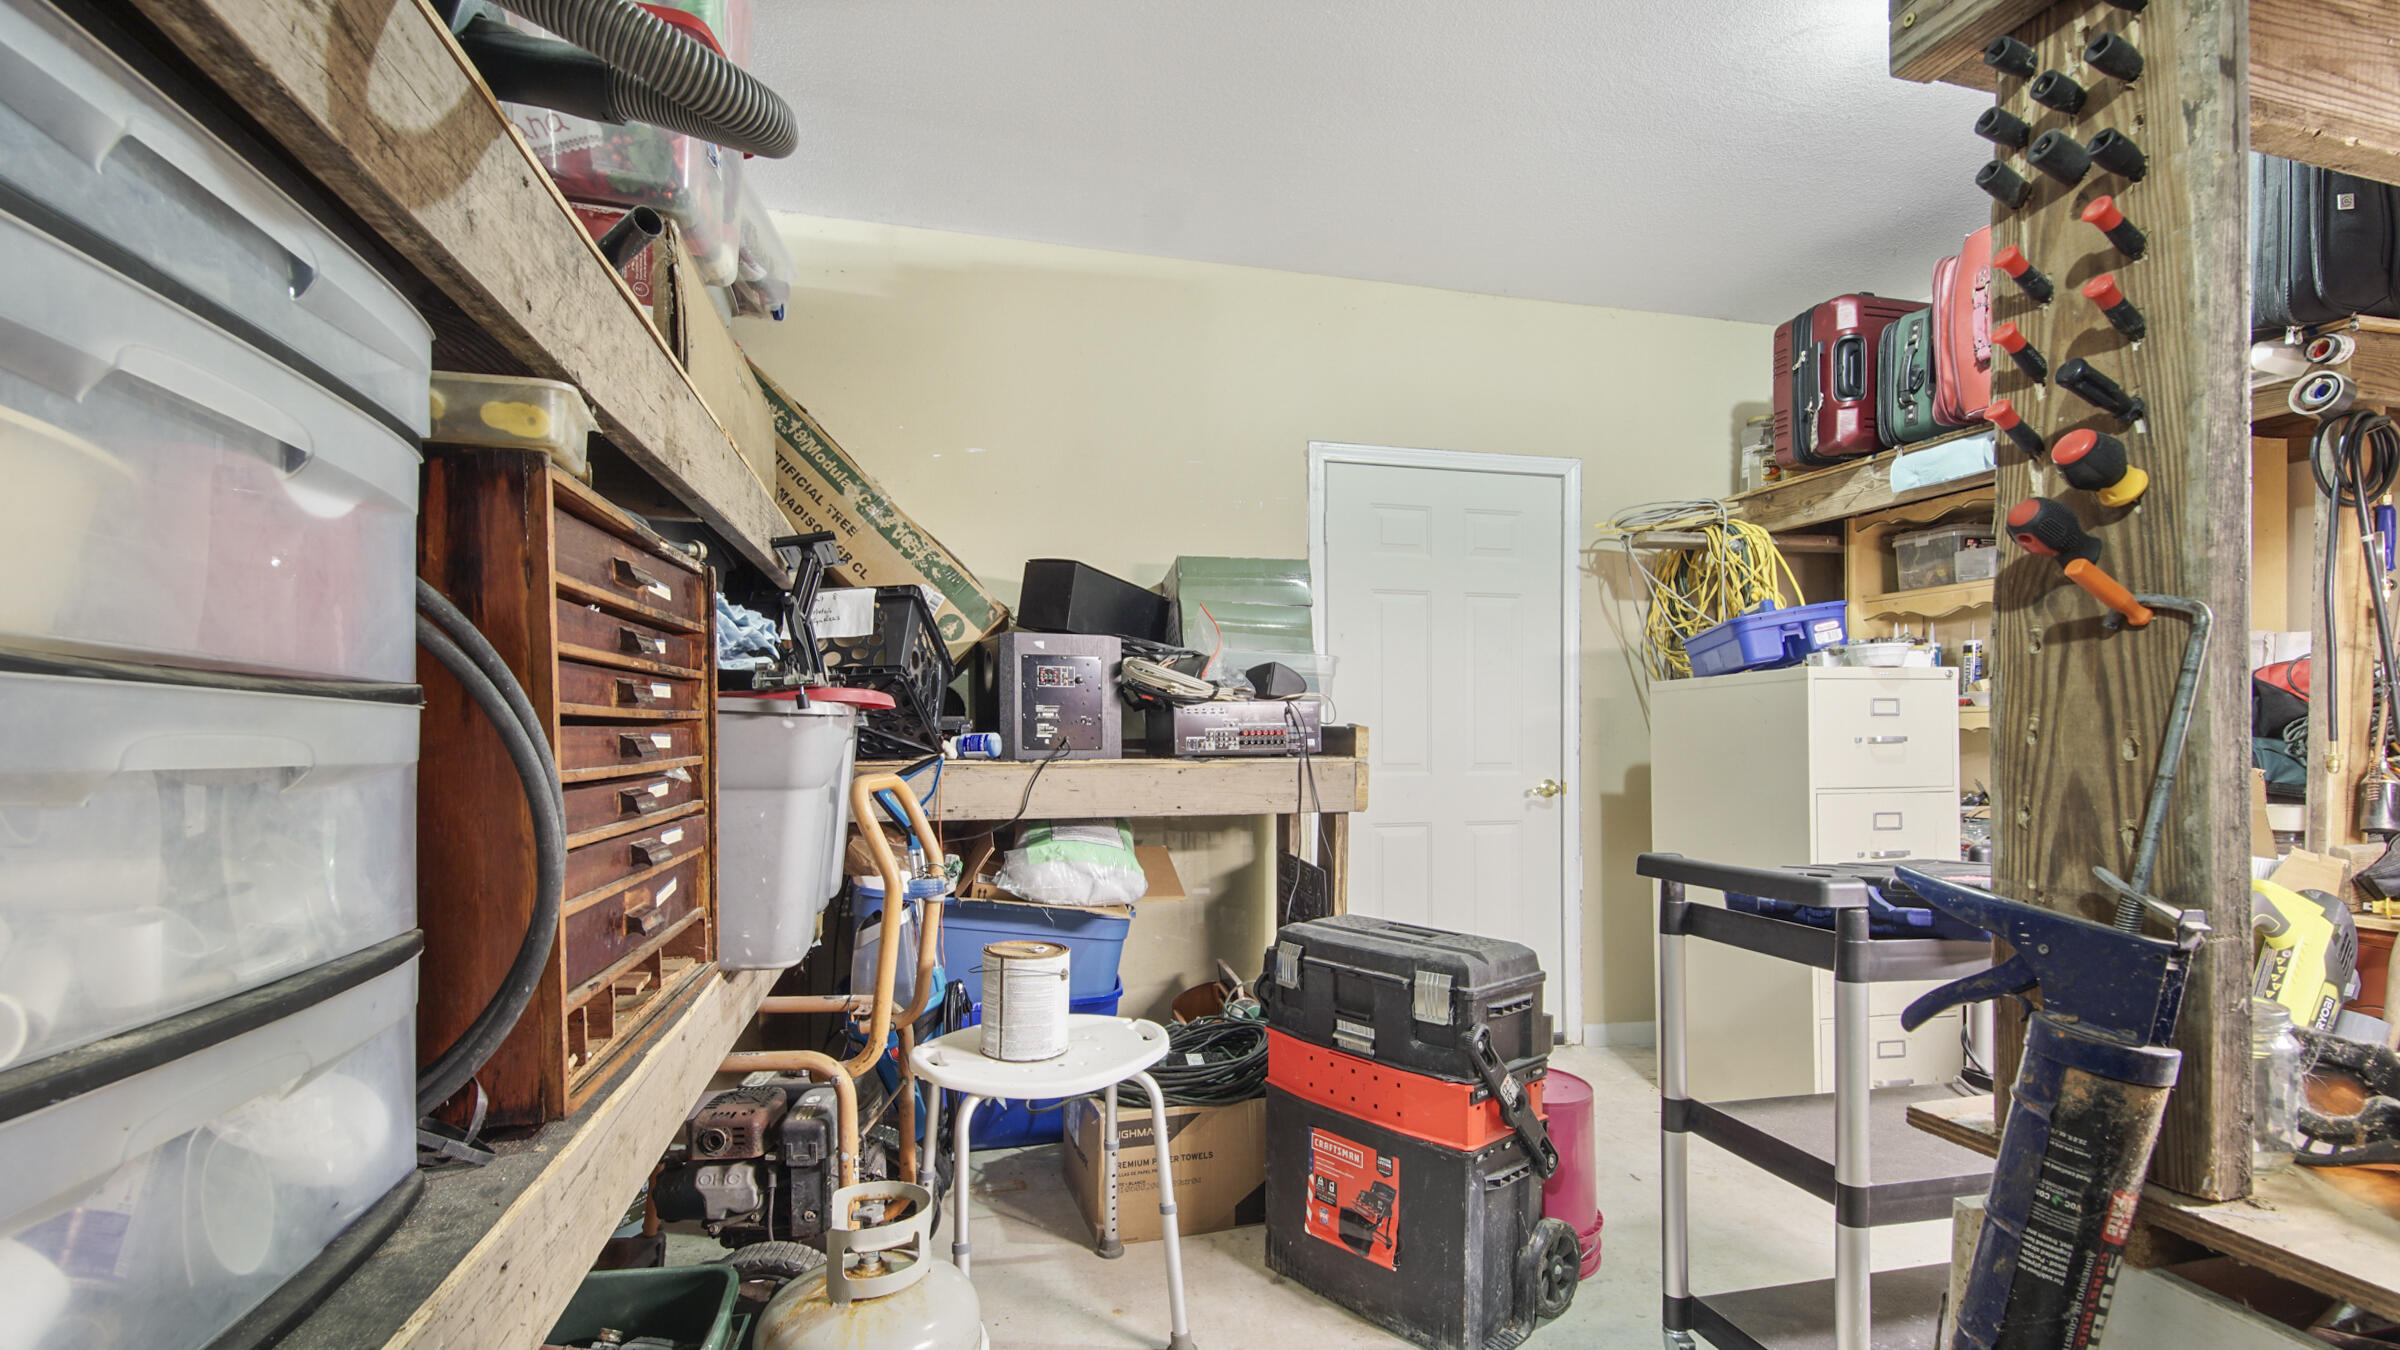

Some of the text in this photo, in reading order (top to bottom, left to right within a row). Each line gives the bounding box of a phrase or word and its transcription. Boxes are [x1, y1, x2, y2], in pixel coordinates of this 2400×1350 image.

[776, 450, 858, 538] TIFICIAL TREE
[779, 487, 824, 534] MADISO
[852, 562, 870, 581] CL
[2315, 997, 2335, 1031] RYOBI
[1118, 1151, 1214, 1170] REMIUM PER TOWELS
[1314, 1138, 1361, 1164] CRAFTSMAN
[698, 1173, 742, 1187] OHC
[2086, 1253, 2123, 1350] SUB
